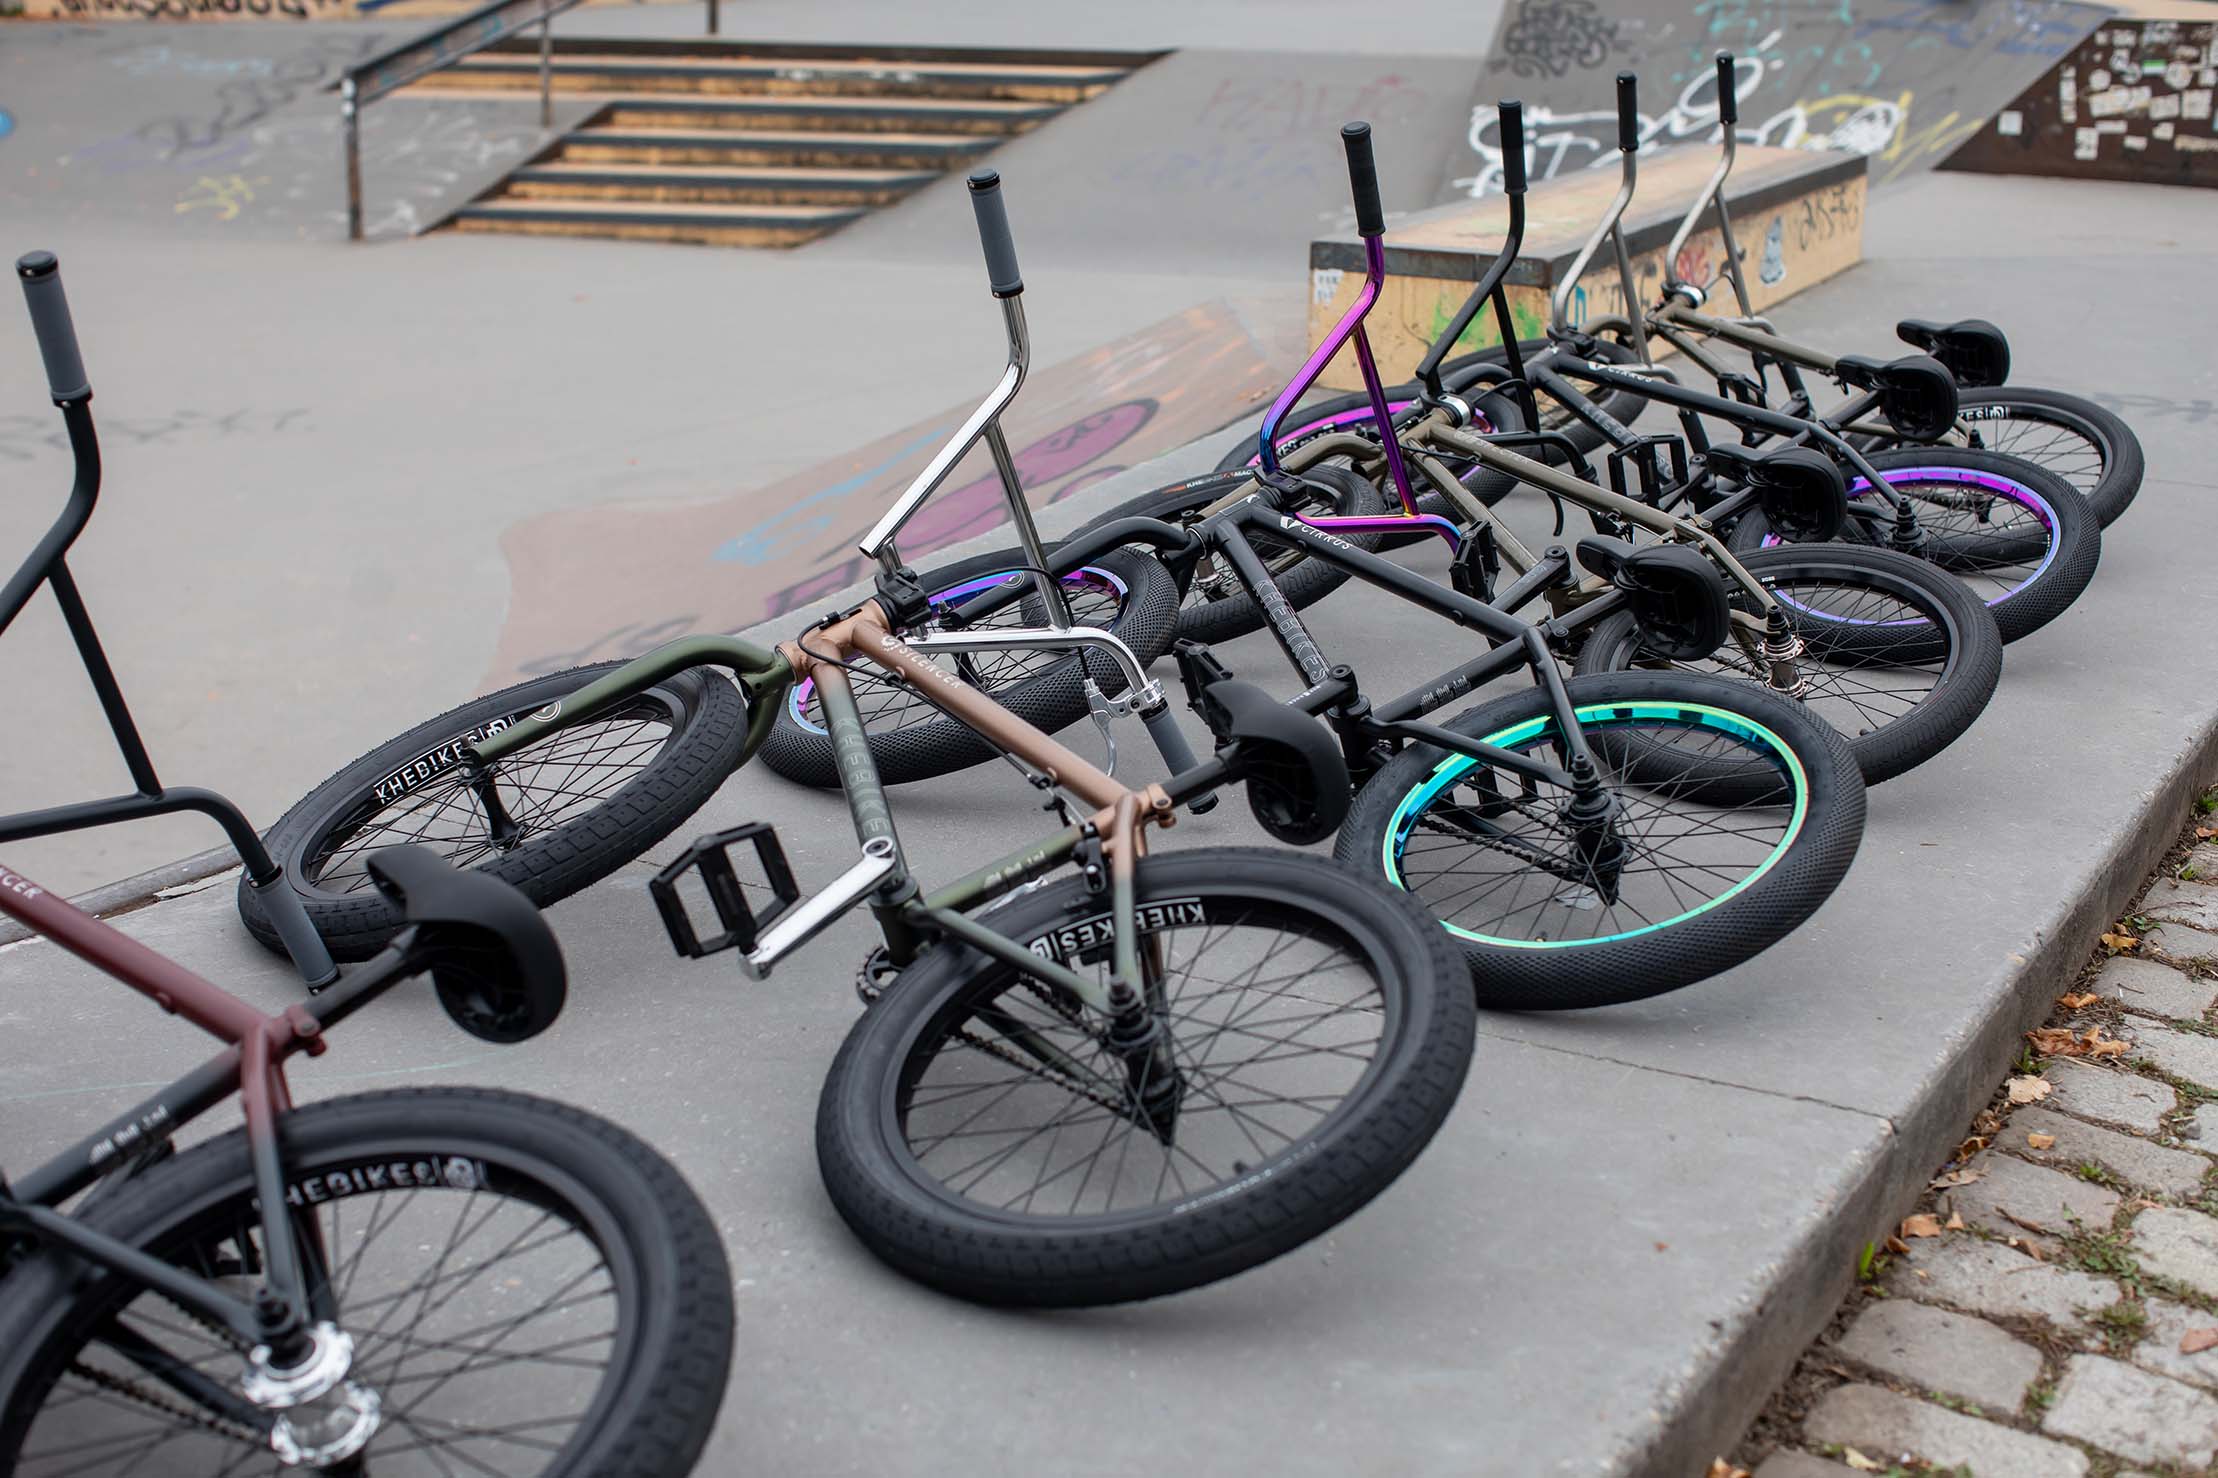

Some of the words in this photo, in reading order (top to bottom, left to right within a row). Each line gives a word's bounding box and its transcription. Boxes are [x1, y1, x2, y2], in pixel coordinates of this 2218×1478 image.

[1301, 526, 1351, 550] CIRRUS
[1252, 579, 1328, 684] KHEBIKES
[899, 647, 961, 689] SILENCER
[828, 717, 893, 837] KHEBIKE
[1060, 903, 1206, 952] KHEBKES
[256, 1160, 436, 1209] HEBIKES
